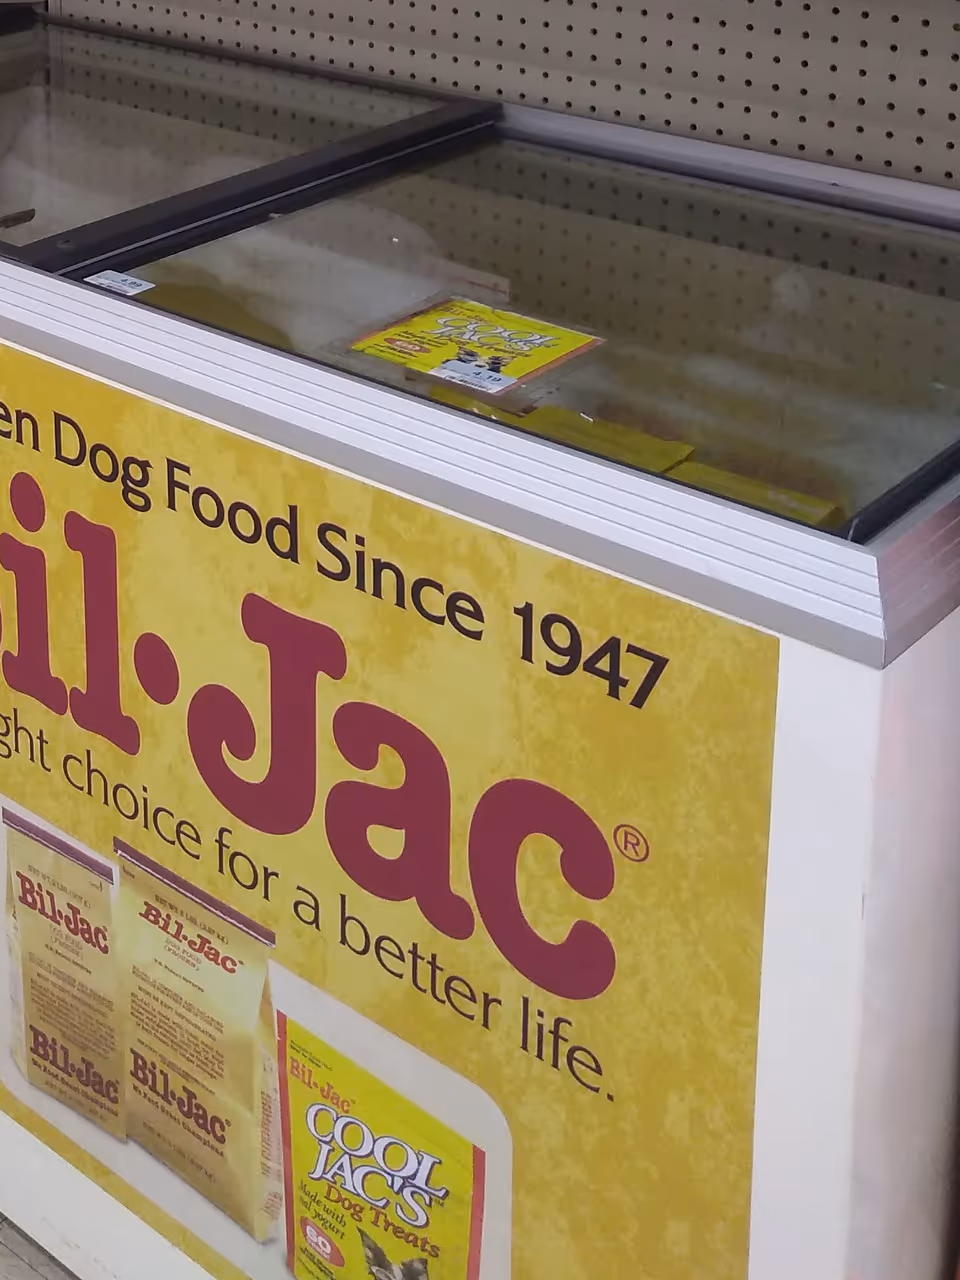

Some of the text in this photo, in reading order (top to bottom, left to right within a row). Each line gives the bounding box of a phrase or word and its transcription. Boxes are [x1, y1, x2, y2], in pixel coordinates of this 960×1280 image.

[53, 413, 152, 514] Dog
[166, 457, 301, 563] Food
[316, 531, 485, 643] Since
[512, 603, 670, 710] 1947
[62, 749, 202, 861] choice
[214, 826, 281, 902] for
[293, 880, 322, 930] a
[338, 893, 502, 1031] better
[521, 995, 617, 1103] life.
[305, 1102, 450, 1201] COOL
[307, 1139, 433, 1228] JAC'S
[312, 1208, 346, 1240] yogurt
[322, 1203, 347, 1228] with
[323, 1183, 440, 1259] Dog Treats
